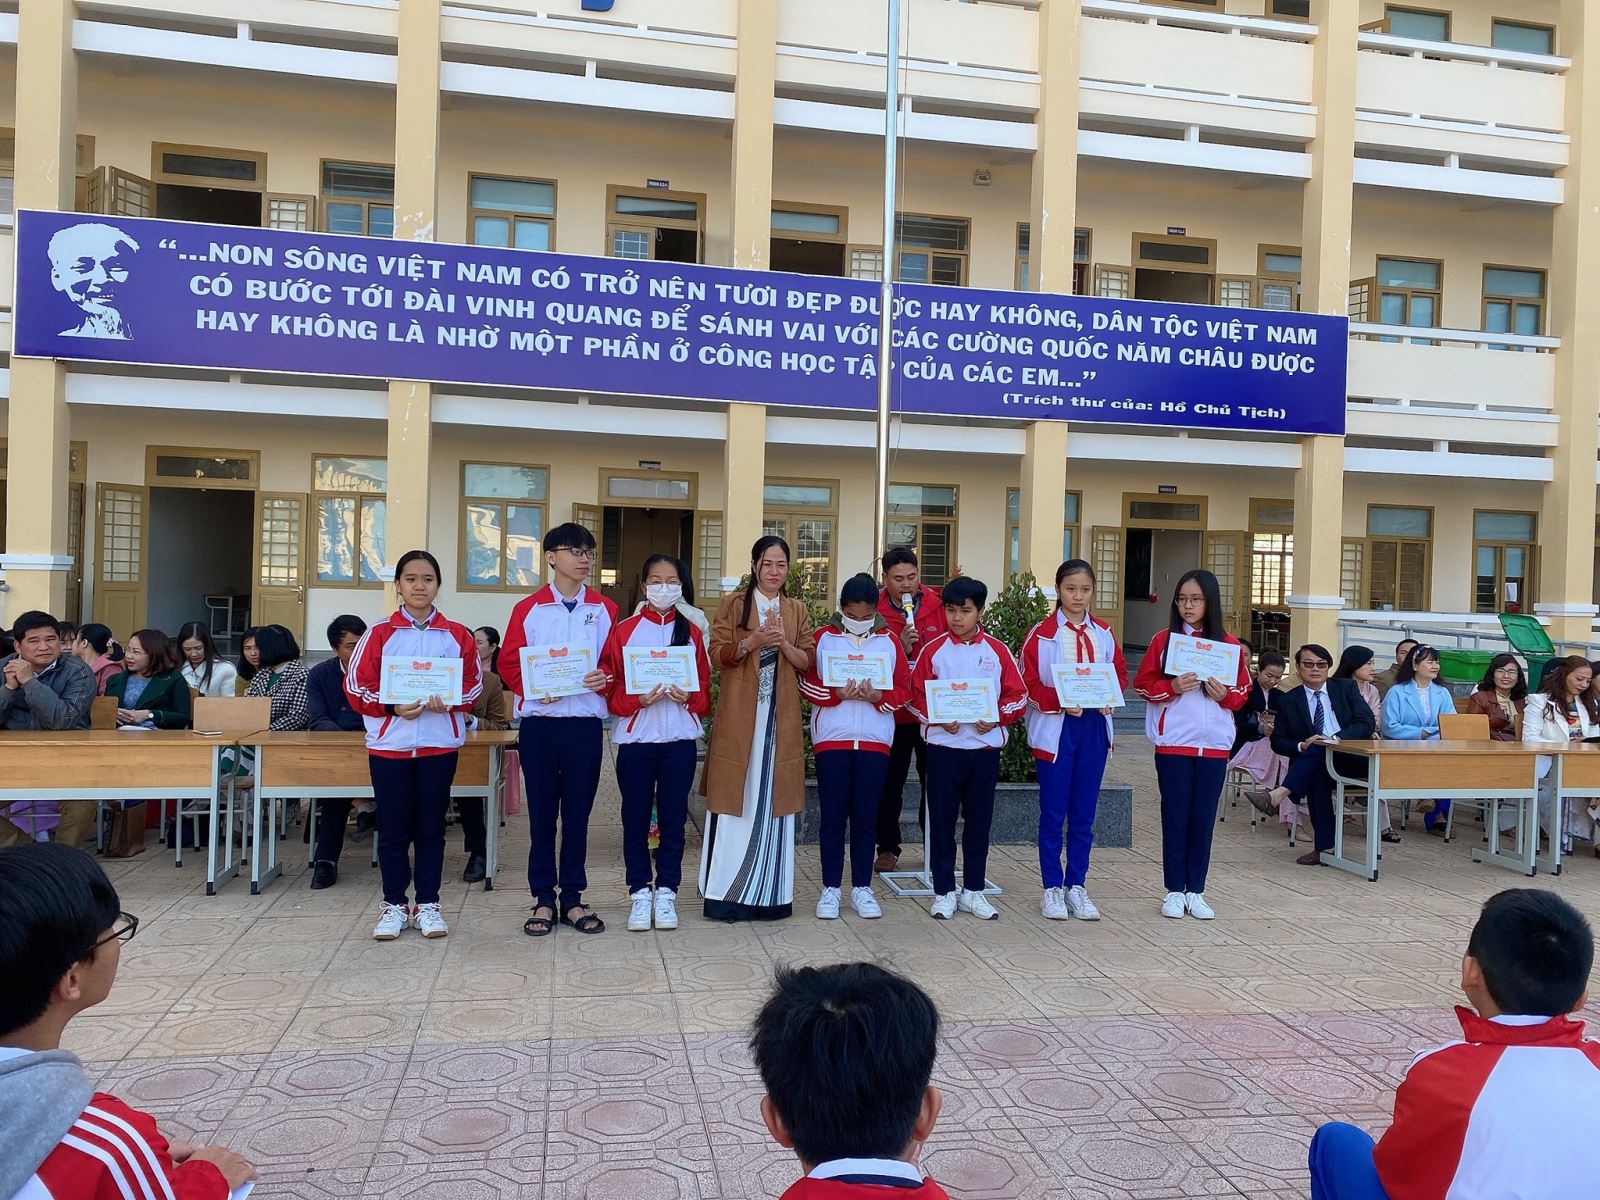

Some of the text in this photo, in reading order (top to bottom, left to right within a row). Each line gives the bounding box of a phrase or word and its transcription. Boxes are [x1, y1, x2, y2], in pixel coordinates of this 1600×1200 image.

[189, 271, 1316, 375] CÓ BƯỚC TỚI ĐÀI VINH QUANG ĐỂ SÁNH VAI VỚI CÁC CƯỜNG QUỐC NĂM CHÂU ĐƯỢC
[284, 244, 368, 274] SÔNG
[377, 252, 446, 281] VIỆT
[457, 262, 522, 286] NAM
[532, 265, 571, 289] CÓ
[581, 268, 641, 296] TRỞ
[650, 276, 706, 301] NÊN
[715, 283, 777, 307] TƯƠI
[786, 290, 842, 313] ĐẸP
[931, 301, 982, 321] HAY
[991, 304, 1083, 332] KHÔNG,
[1092, 312, 1143, 333] DÂN
[1151, 316, 1198, 340] TỘC
[1206, 319, 1260, 342] VIỆT
[1267, 325, 1317, 346] NAM
[196, 309, 260, 333] HAY
[270, 312, 378, 341] KHÔNG
[387, 318, 425, 344] LÀ
[438, 323, 502, 350] NHỜ
[509, 328, 573, 356] MỘT
[584, 331, 661, 362] PHẦN
[670, 336, 691, 364] Ở
[699, 342, 774, 370] CÔNG
[781, 351, 836, 374] HỌC
[844, 353, 896, 380] TẬ
[903, 355, 955, 381] CỦA
[962, 360, 1013, 384] CÁC
[1002, 392, 1287, 420] (Trích thư của: Hồ Chủ Tịch)
